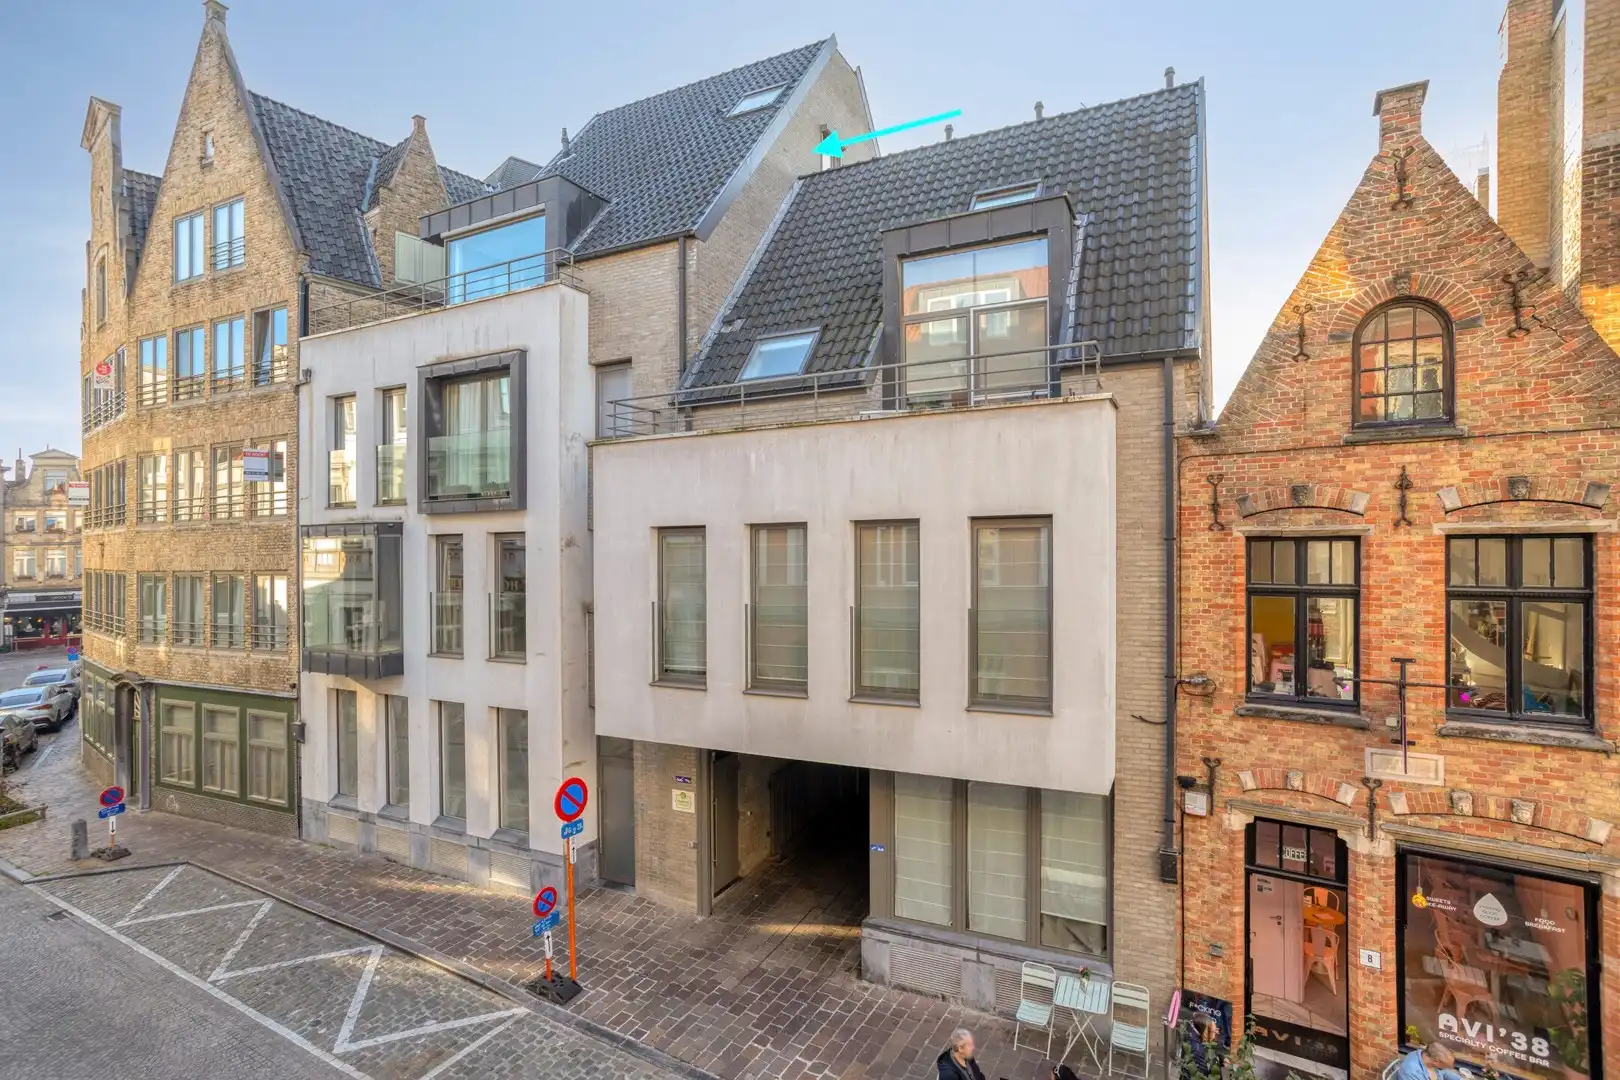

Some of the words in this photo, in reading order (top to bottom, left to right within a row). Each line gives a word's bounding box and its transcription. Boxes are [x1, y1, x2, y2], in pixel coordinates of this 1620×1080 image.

[1426, 896, 1451, 905] SWEETS
[1534, 917, 1556, 926] FOOD
[1524, 921, 1566, 934] BREAKFAST
[1367, 954, 1373, 963] 8
[1438, 1031, 1487, 1049] SPECIALTY
[1488, 1045, 1528, 1061] COFFEE
[1529, 1055, 1550, 1068] BAR
